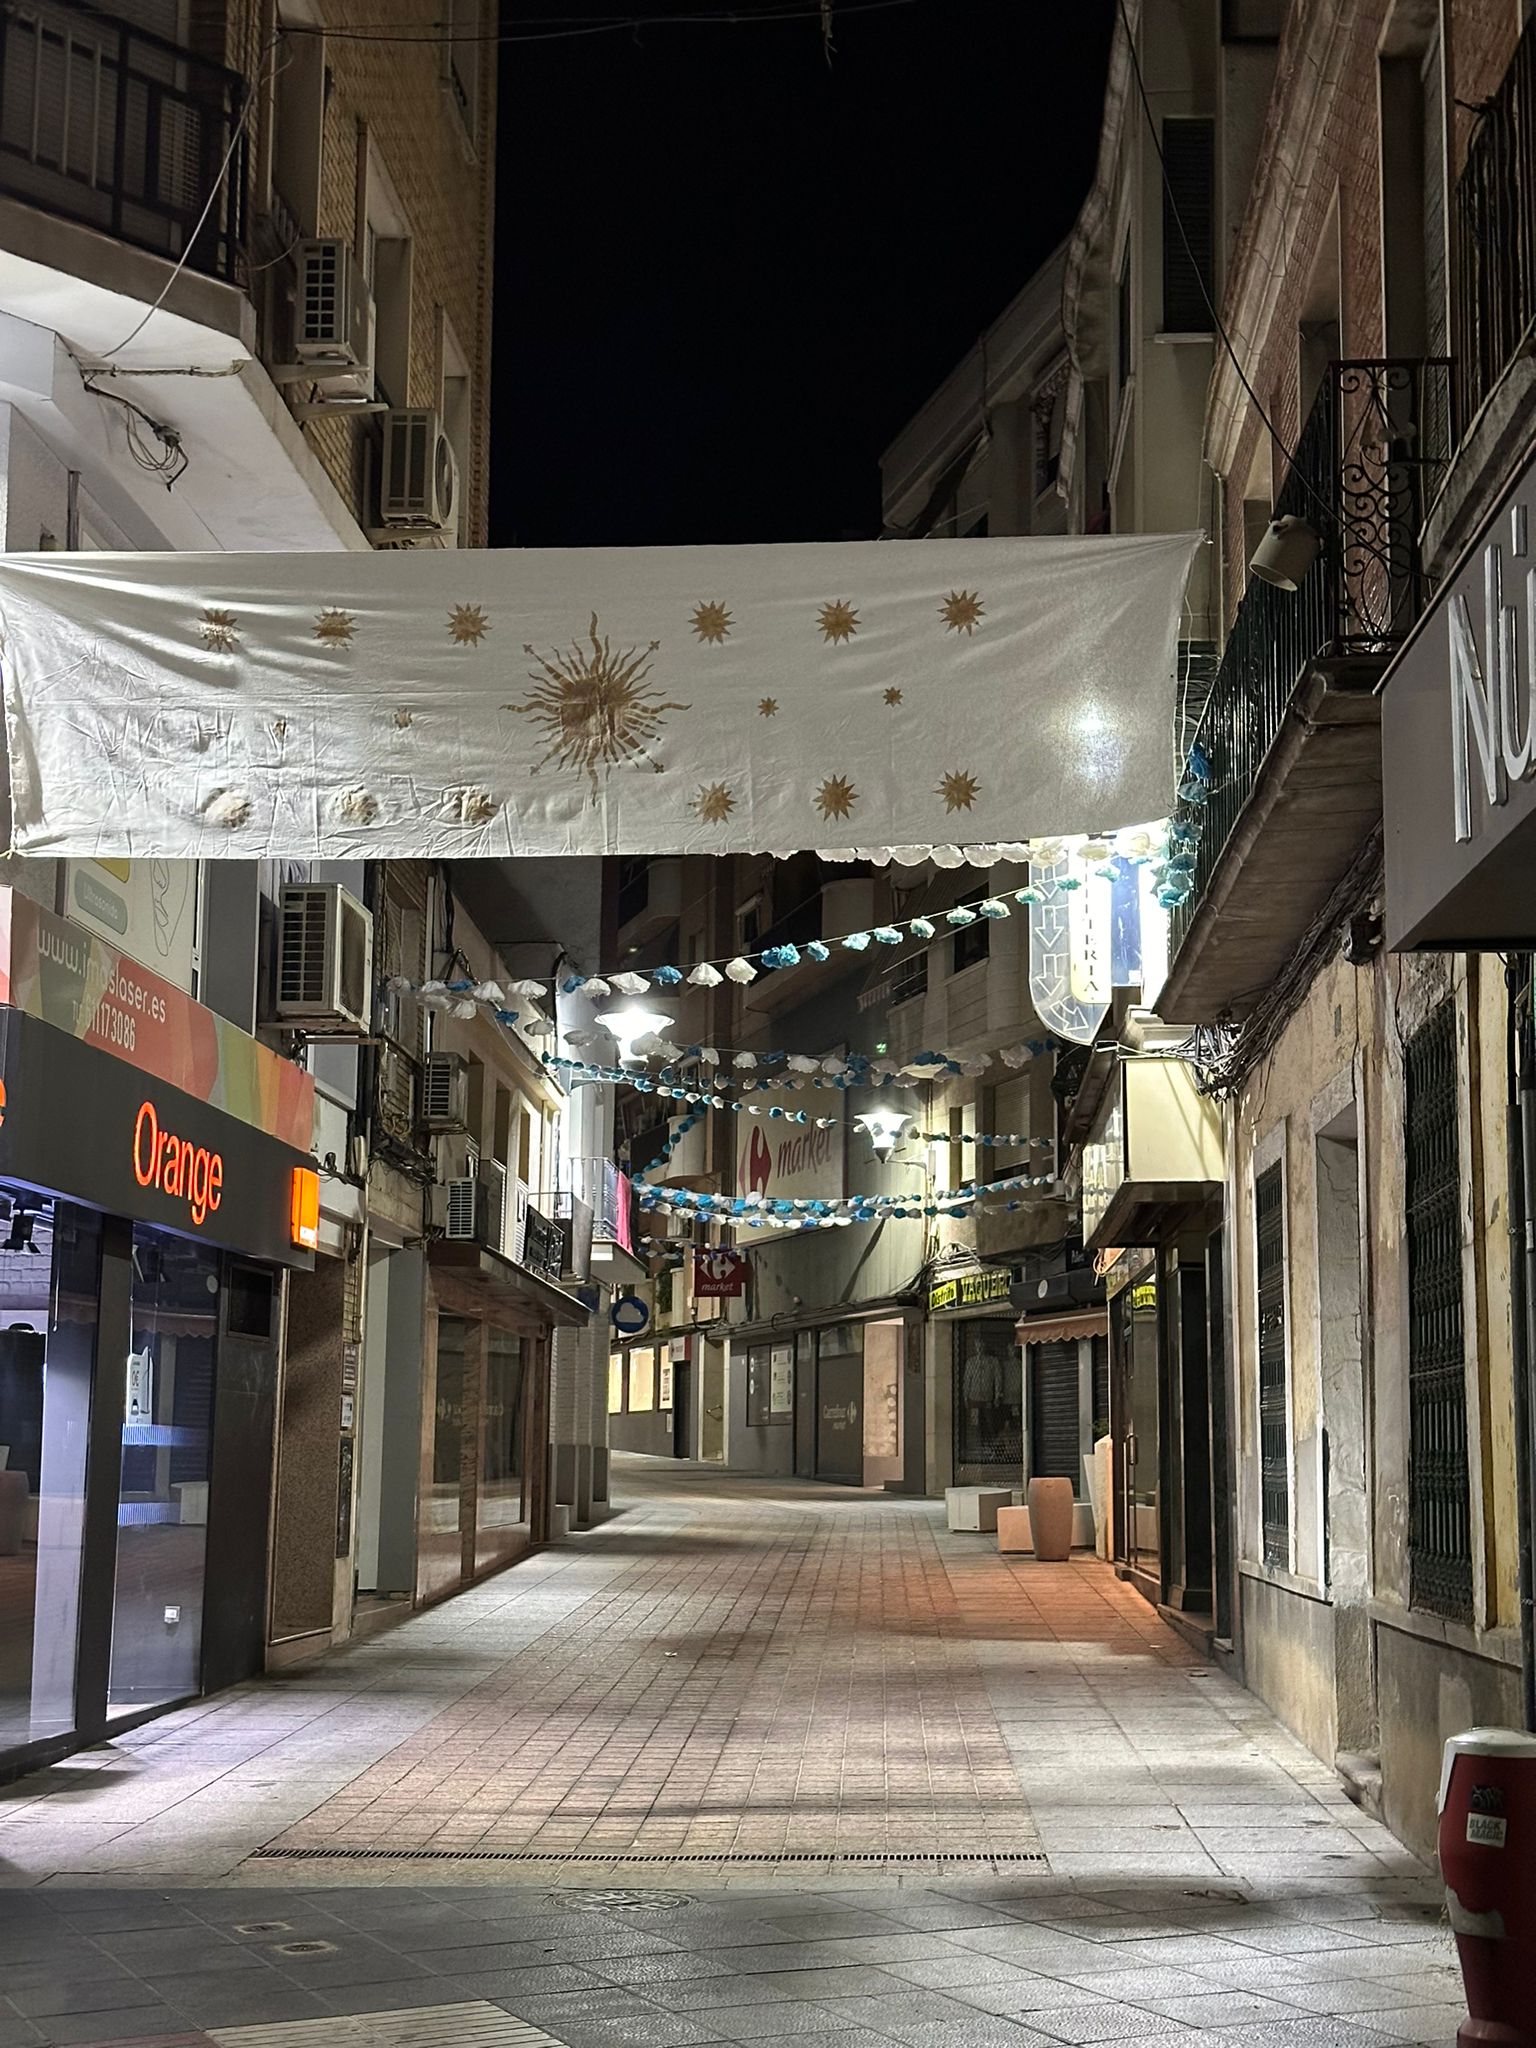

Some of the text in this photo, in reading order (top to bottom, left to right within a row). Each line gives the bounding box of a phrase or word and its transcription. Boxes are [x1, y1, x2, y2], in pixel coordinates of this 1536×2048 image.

[777, 1112, 832, 1179] market
[133, 1101, 223, 1225] Orange
[700, 1281, 735, 1293] market
[1469, 1818, 1502, 1831] BLACK
[1470, 1827, 1504, 1841] MAGIC
